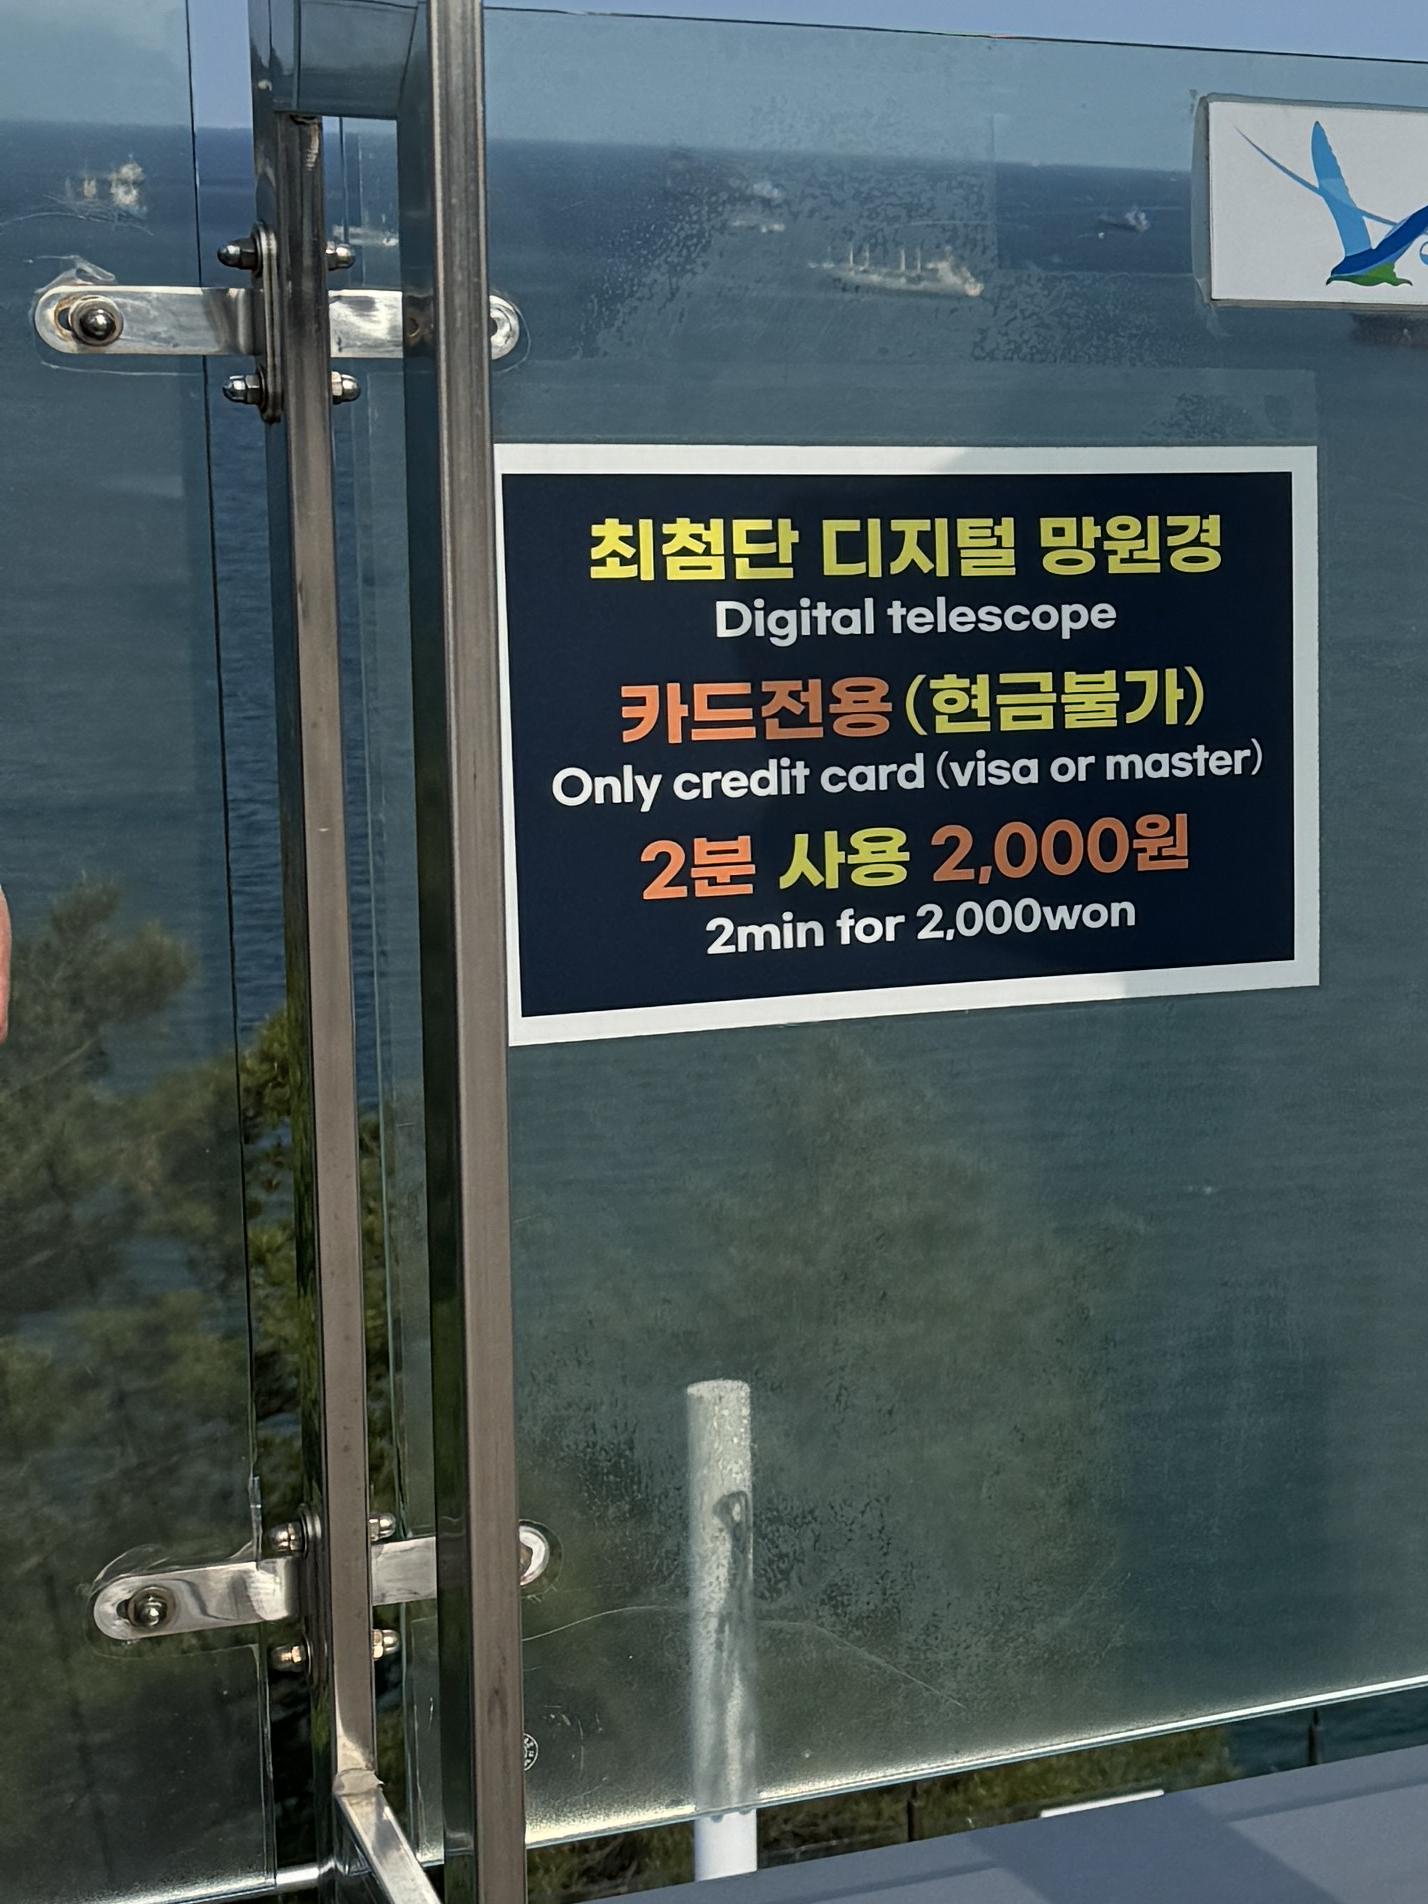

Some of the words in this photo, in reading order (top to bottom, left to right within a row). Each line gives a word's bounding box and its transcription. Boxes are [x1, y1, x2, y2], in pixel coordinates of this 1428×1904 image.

[589, 517, 799, 582] 최첨단
[822, 516, 1018, 578] 디지털
[1040, 513, 1223, 575] 망원경
[715, 597, 875, 647] Digital
[886, 595, 1118, 641] telescope
[551, 767, 663, 813] Only
[672, 756, 810, 800] credit
[819, 751, 926, 794] card
[935, 747, 1040, 792] (visa
[1048, 752, 1096, 785] or
[1105, 737, 1264, 783] master)
[640, 836, 754, 901] 2분
[779, 825, 911, 891] 사용
[930, 813, 1190, 886] 2,000원
[705, 912, 825, 956] 2min
[836, 905, 906, 948] for
[916, 896, 1137, 945] 2,000won
